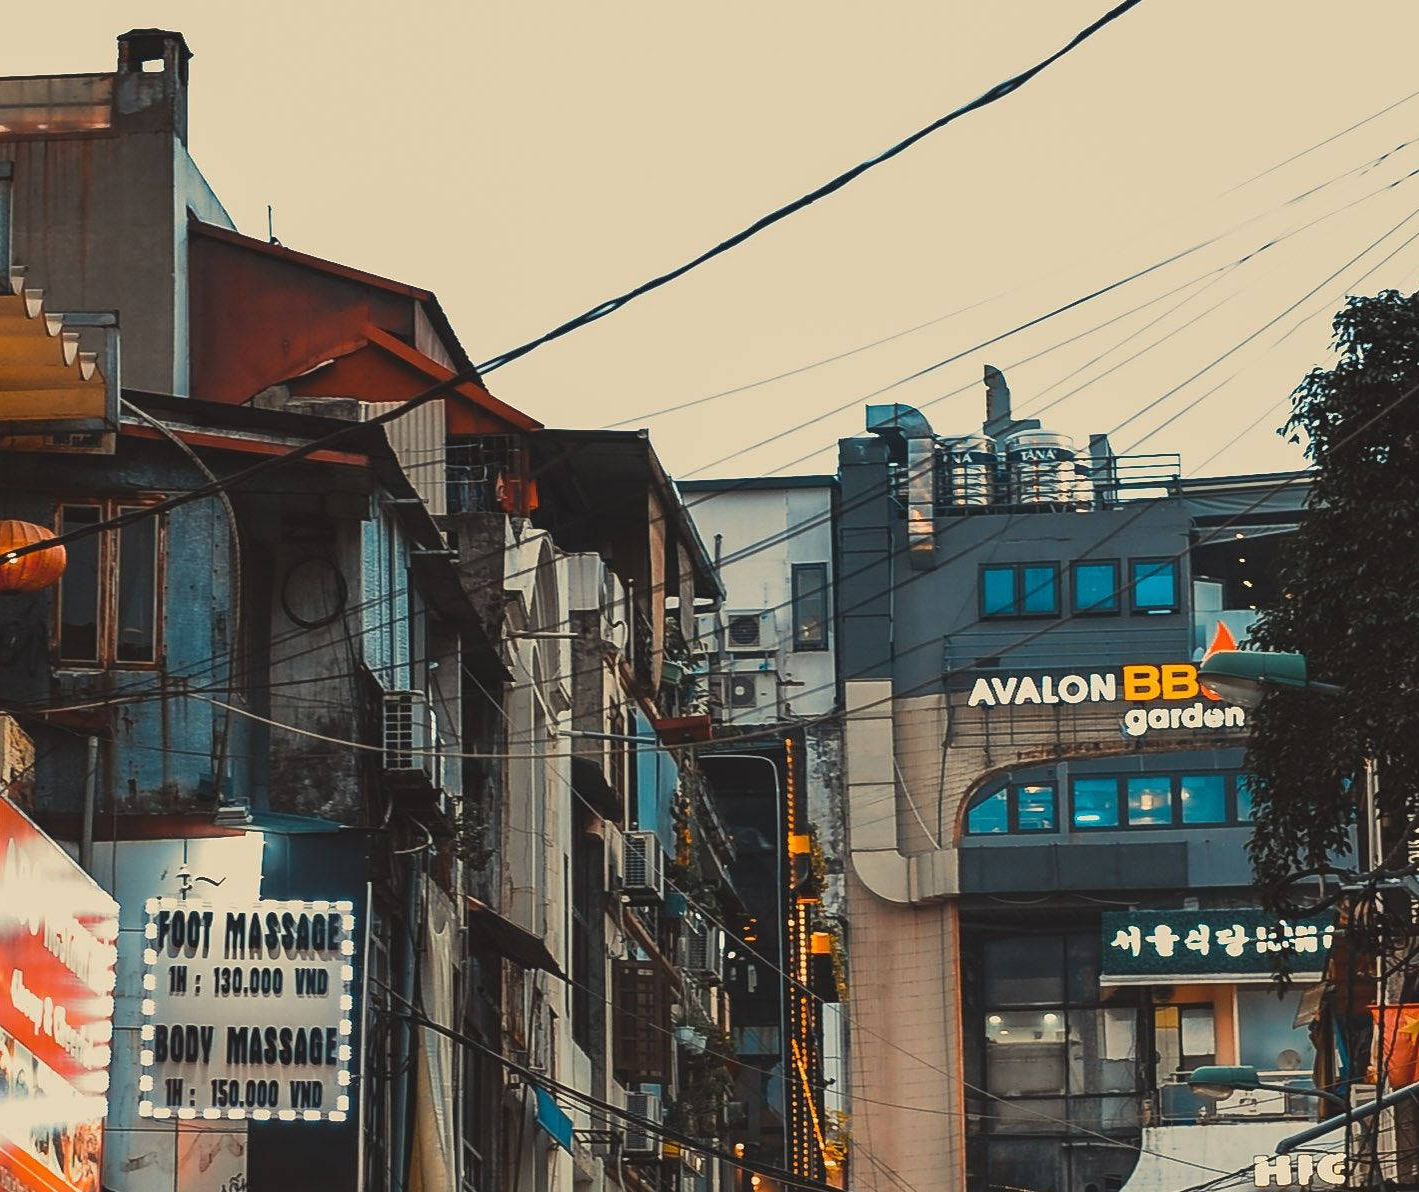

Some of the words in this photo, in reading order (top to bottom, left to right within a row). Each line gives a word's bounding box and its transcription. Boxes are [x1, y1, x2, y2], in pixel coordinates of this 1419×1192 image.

[968, 673, 1116, 707] AVALON
[1122, 663, 1223, 702] BB
[1124, 702, 1246, 737] garden
[157, 910, 214, 955] FOOT
[225, 911, 342, 956] MASSAGE
[168, 965, 187, 995] 1H
[214, 966, 283, 996] 130.000
[294, 968, 329, 997] VND
[155, 1024, 214, 1064] BODY
[226, 1026, 337, 1065] MASSAGE
[165, 1079, 184, 1107] 1H
[211, 1079, 279, 1108] 150.000
[290, 1080, 322, 1108] VND
